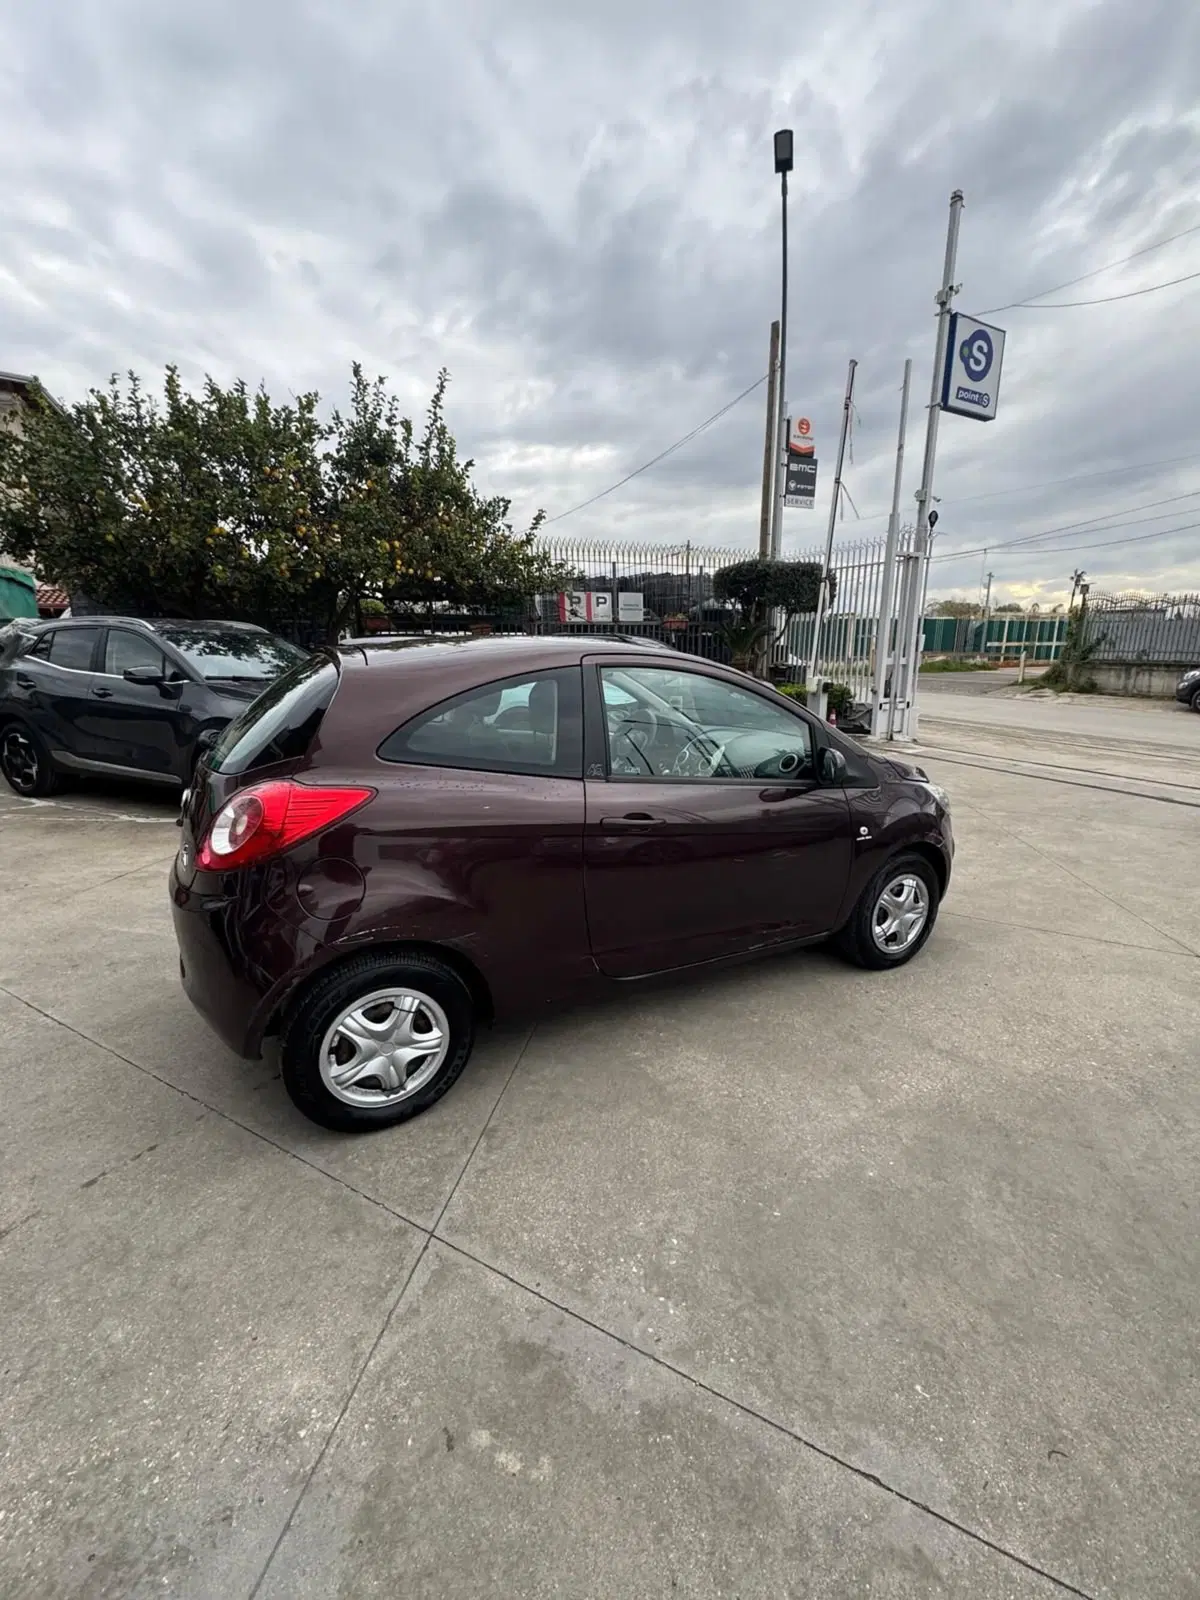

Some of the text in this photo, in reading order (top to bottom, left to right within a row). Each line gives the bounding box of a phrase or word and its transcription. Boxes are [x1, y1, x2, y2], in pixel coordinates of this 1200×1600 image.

[970, 340, 988, 371] S
[787, 497, 813, 506] SERVICE
[597, 596, 607, 607] P
